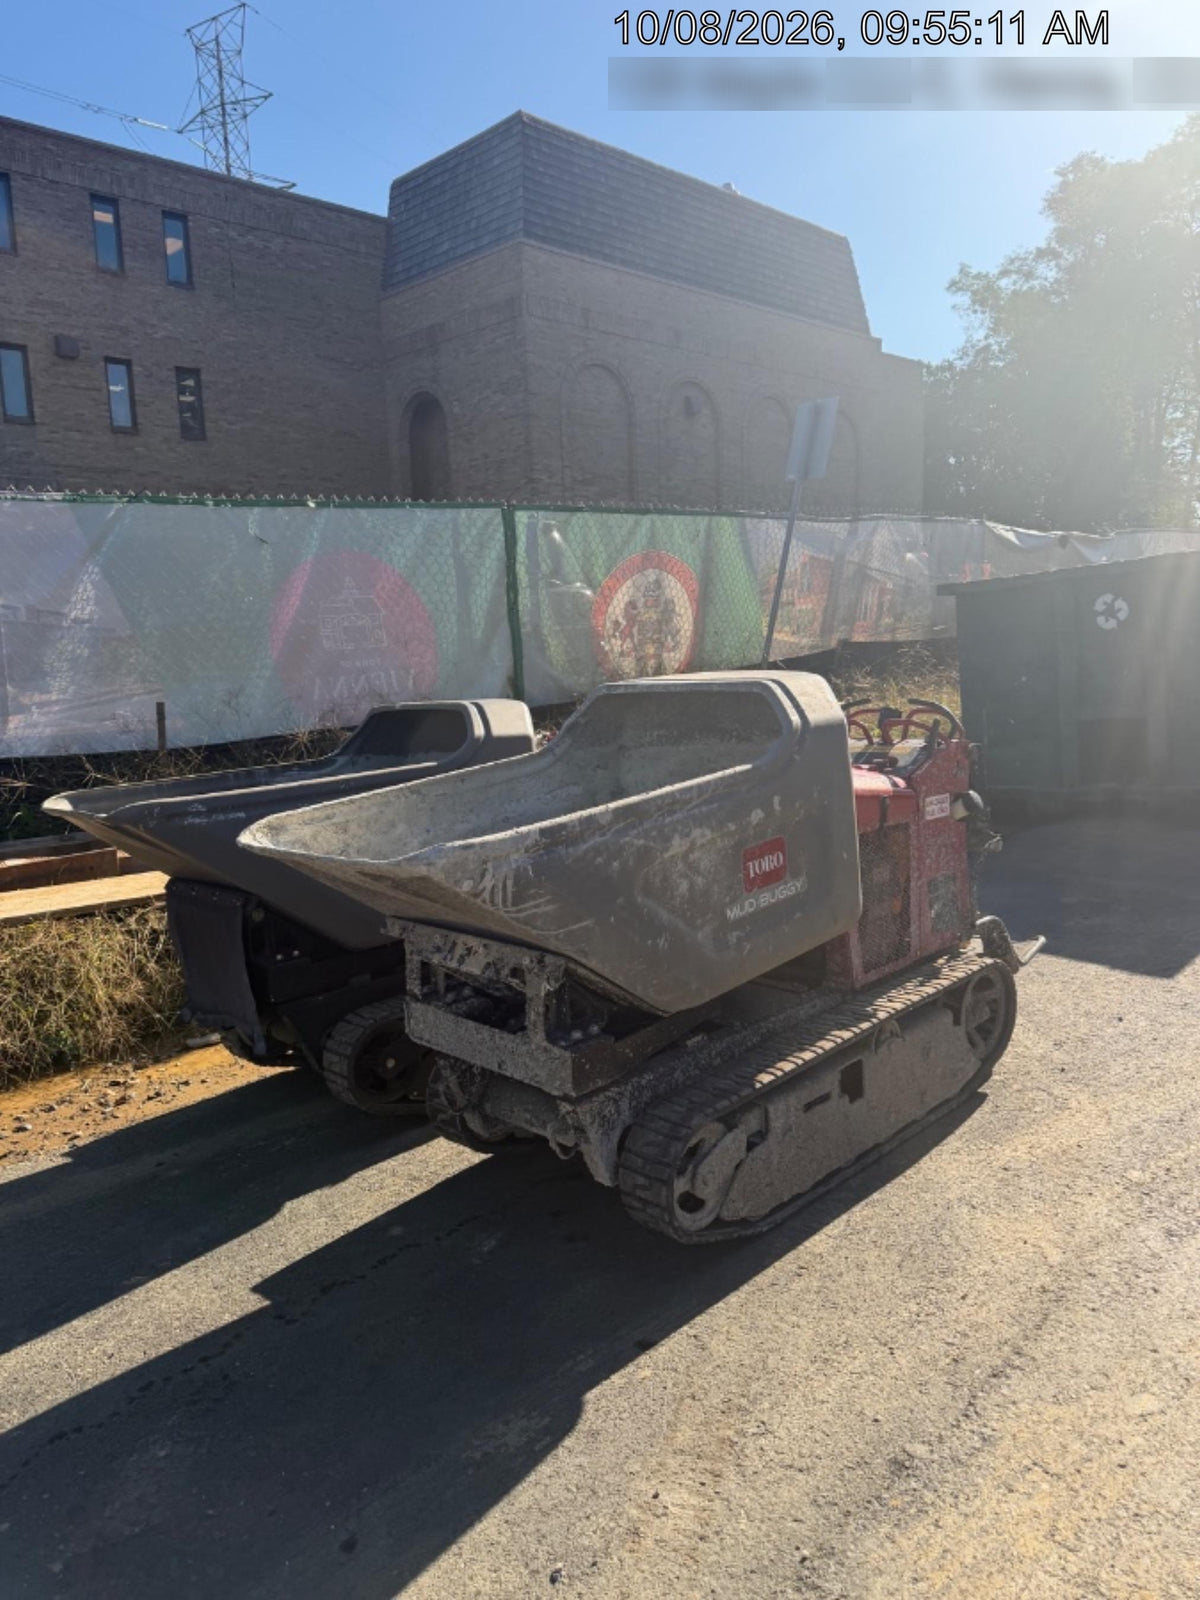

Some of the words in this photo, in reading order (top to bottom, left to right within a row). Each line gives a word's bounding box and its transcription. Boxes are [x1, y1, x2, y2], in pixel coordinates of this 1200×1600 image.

[746, 851, 784, 878] TORO
[726, 899, 757, 920] MUD
[759, 879, 805, 908] BUGGY
